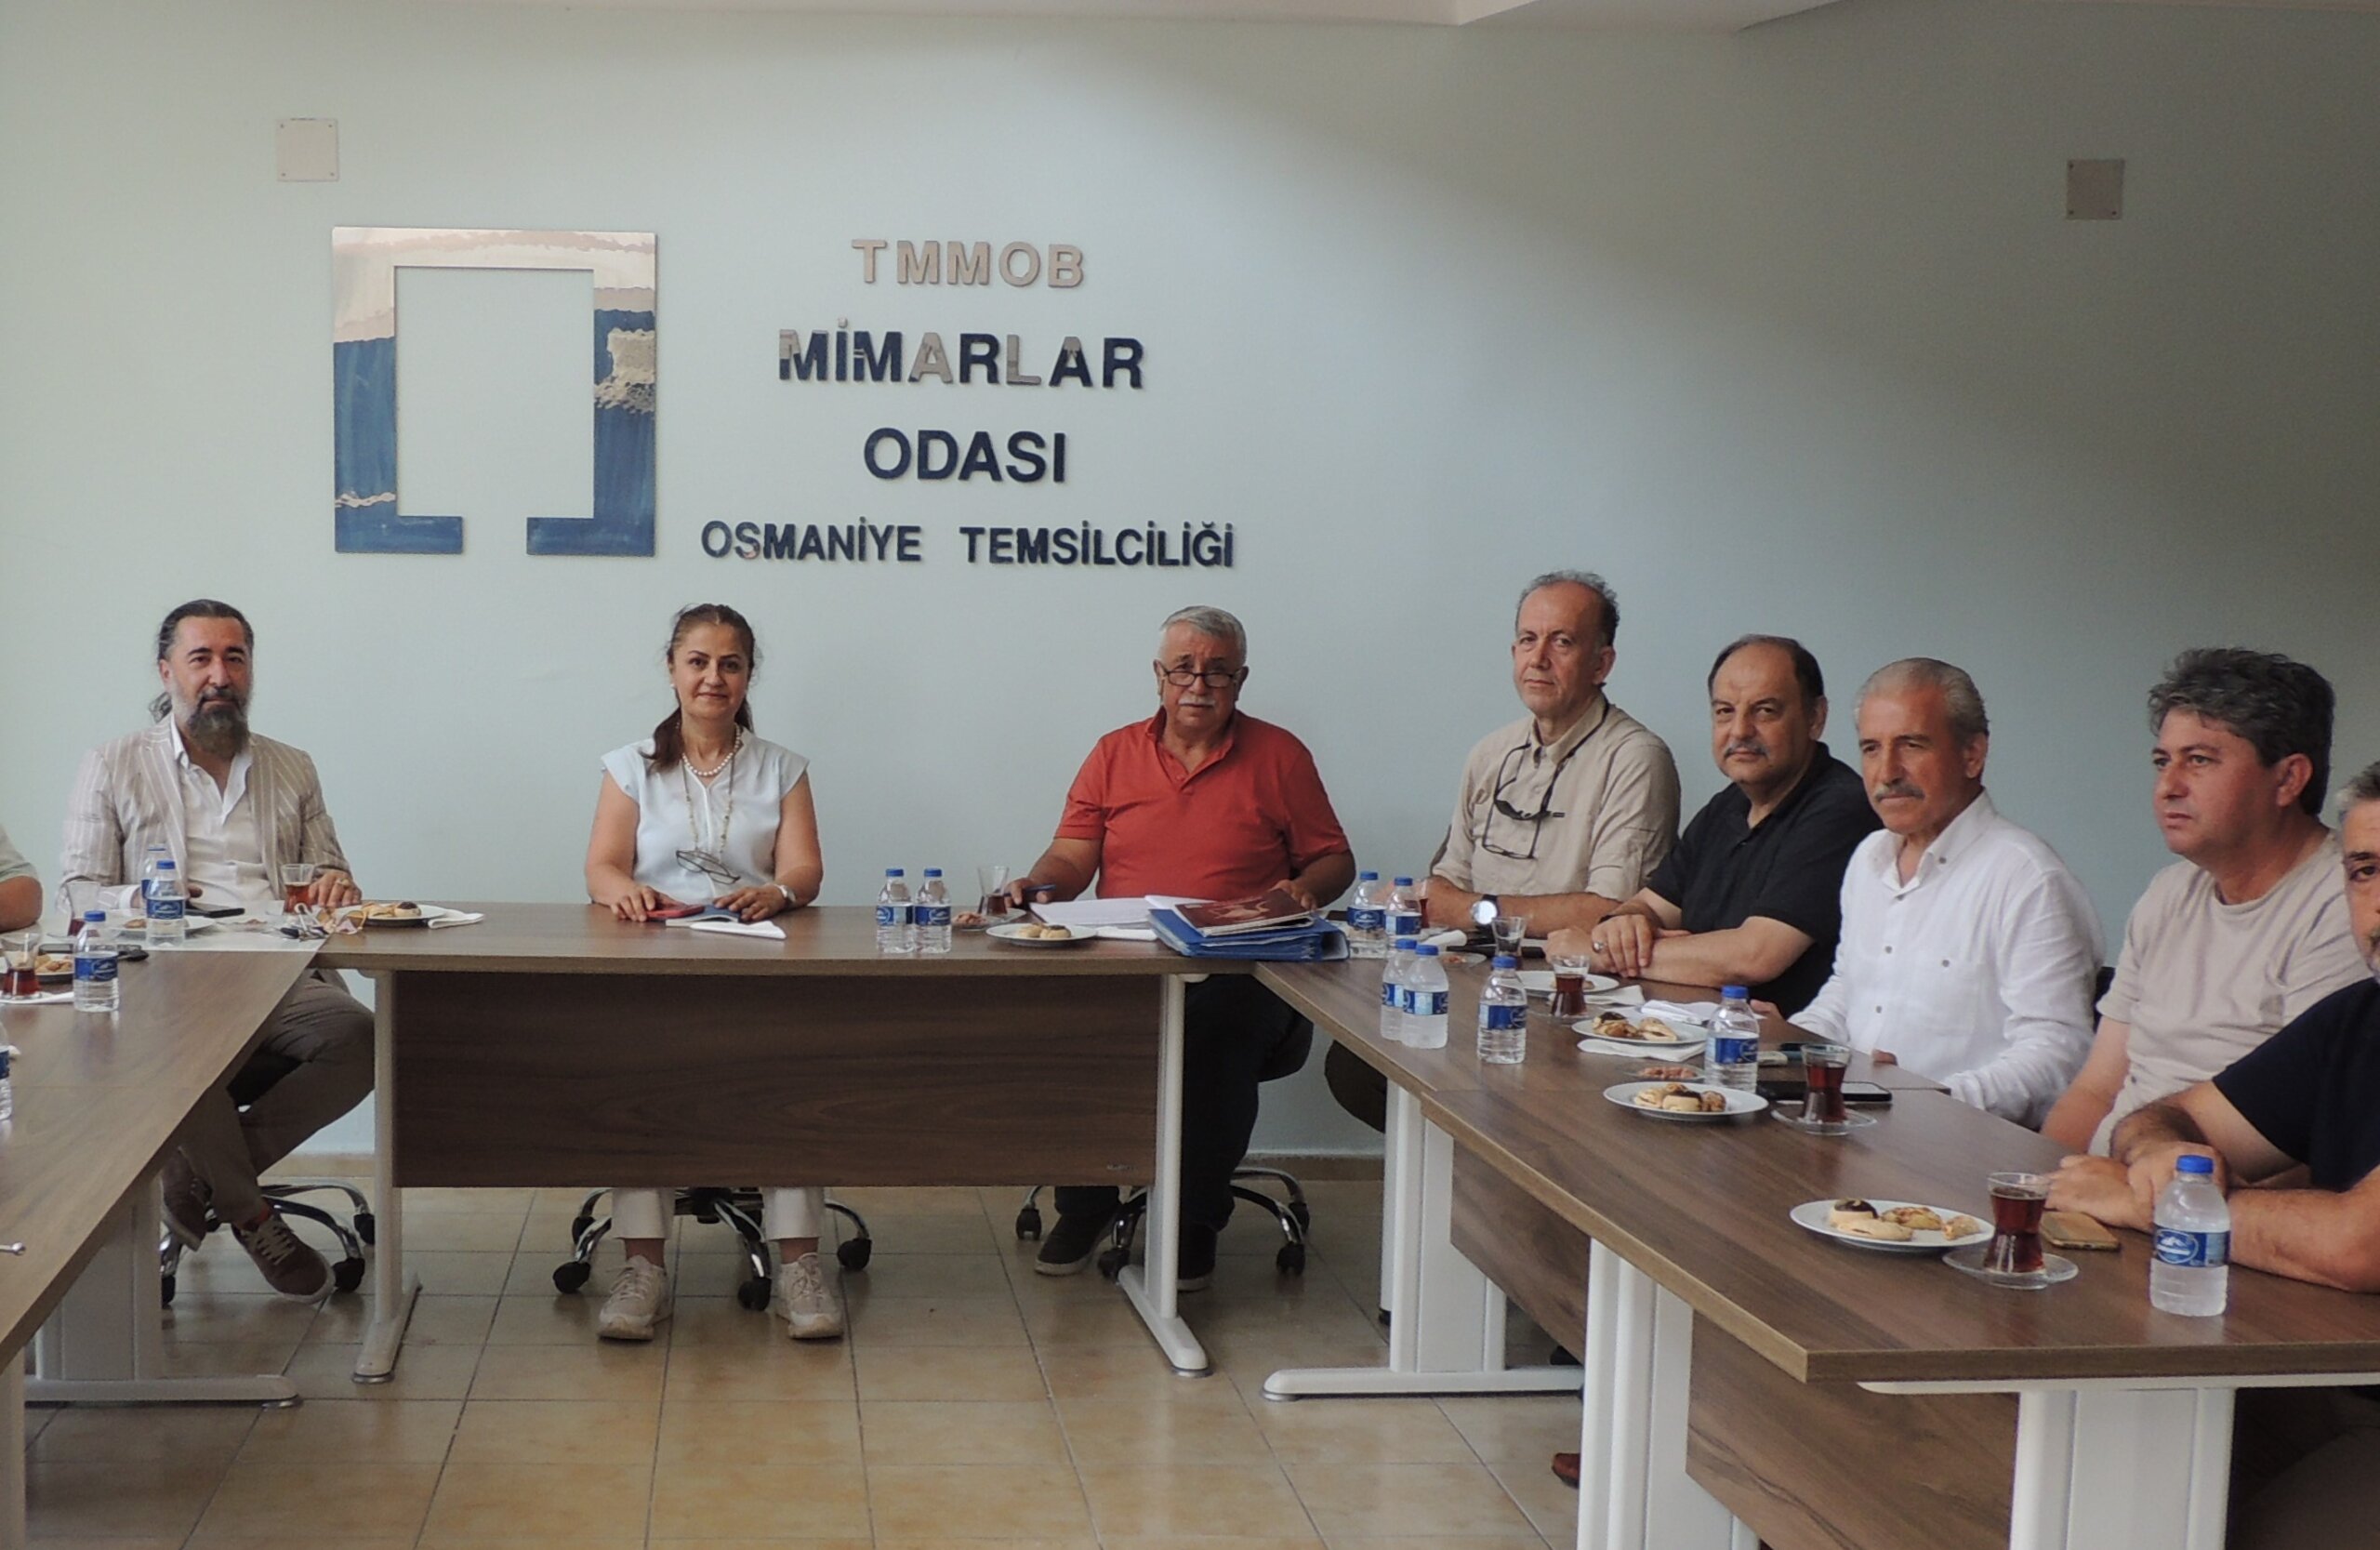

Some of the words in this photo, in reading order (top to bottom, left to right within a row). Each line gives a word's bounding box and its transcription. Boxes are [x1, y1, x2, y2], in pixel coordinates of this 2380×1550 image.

[853, 239, 1084, 288] TMMOB
[779, 318, 1144, 389] MİMARLAR
[864, 428, 1066, 483] ODASI
[701, 516, 921, 563] OSMANİYE
[959, 520, 1234, 567] TEMSİLCİLİĞİ
